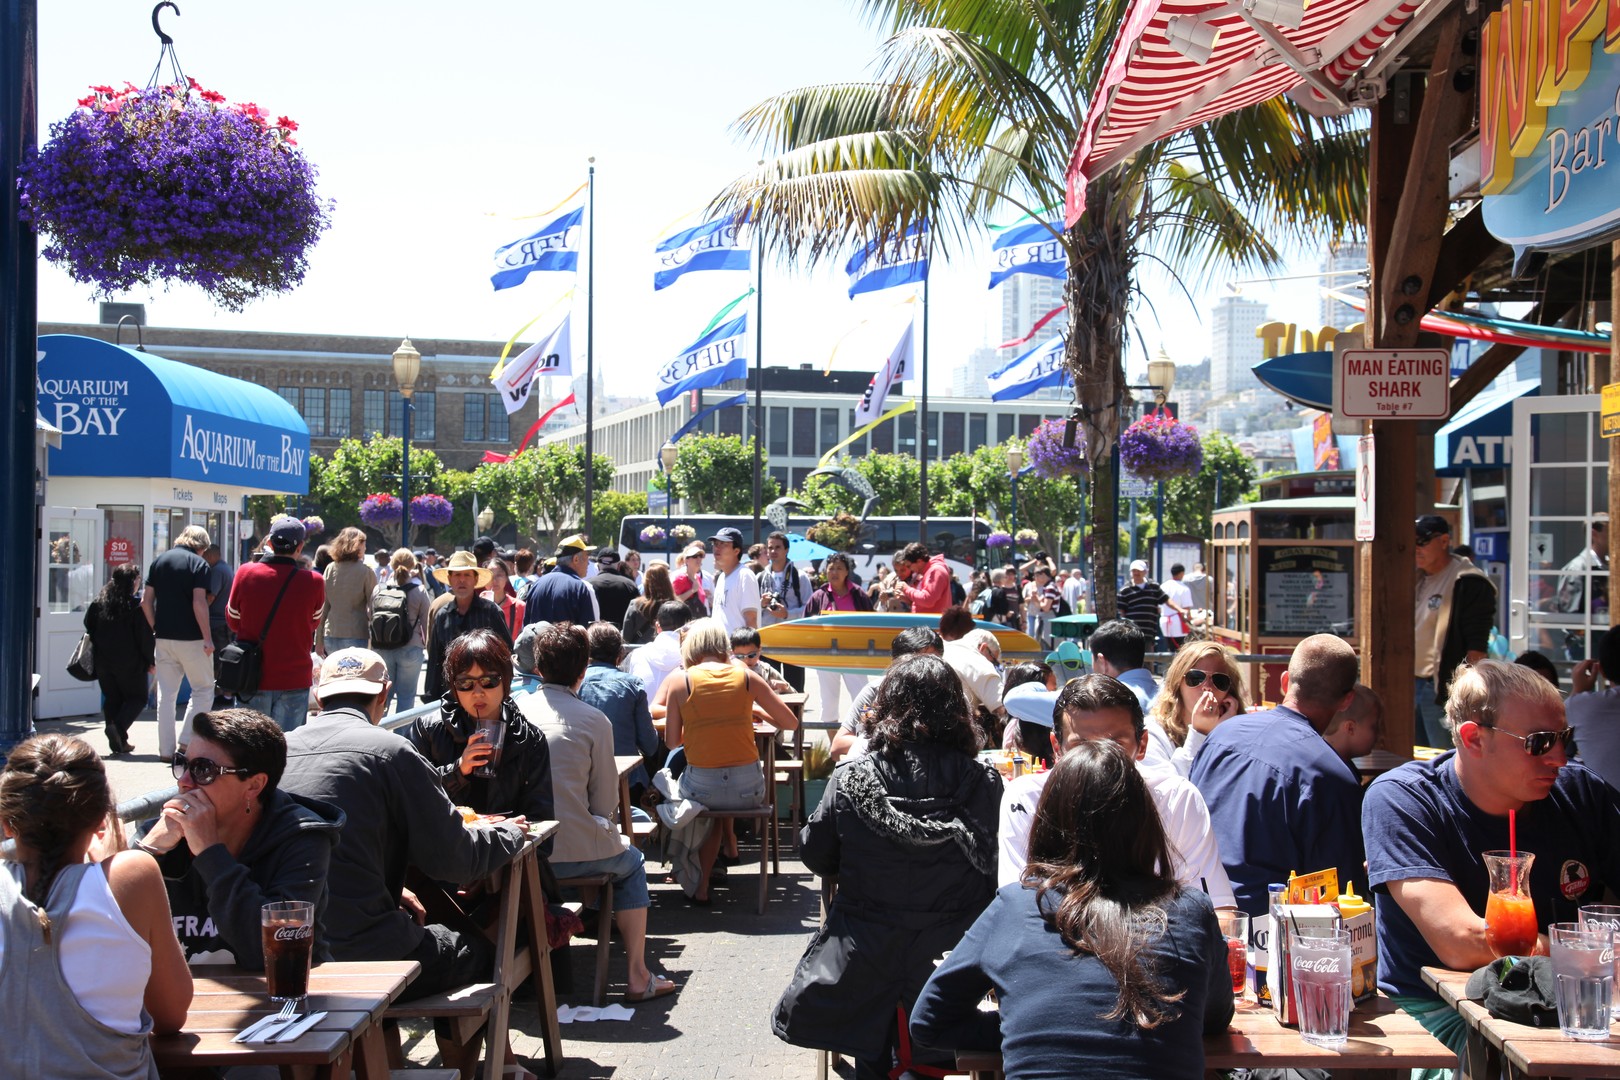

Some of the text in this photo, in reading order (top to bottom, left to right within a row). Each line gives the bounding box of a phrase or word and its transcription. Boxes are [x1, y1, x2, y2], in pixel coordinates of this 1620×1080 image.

[1544, 116, 1611, 215] Bar
[1348, 360, 1443, 376] MAN EATING
[1368, 381, 1422, 397] SHARK
[82, 397, 119, 406] OF THE
[1376, 402, 1413, 411] Table #7
[53, 402, 127, 436] BAY
[180, 414, 305, 476] AQUARIUM OF THE BAY
[173, 487, 193, 502] Tickets
[213, 491, 228, 506] Maps
[111, 541, 127, 551] $10
[172, 915, 219, 938] FRA
[1294, 956, 1340, 973] Coca-Cola
